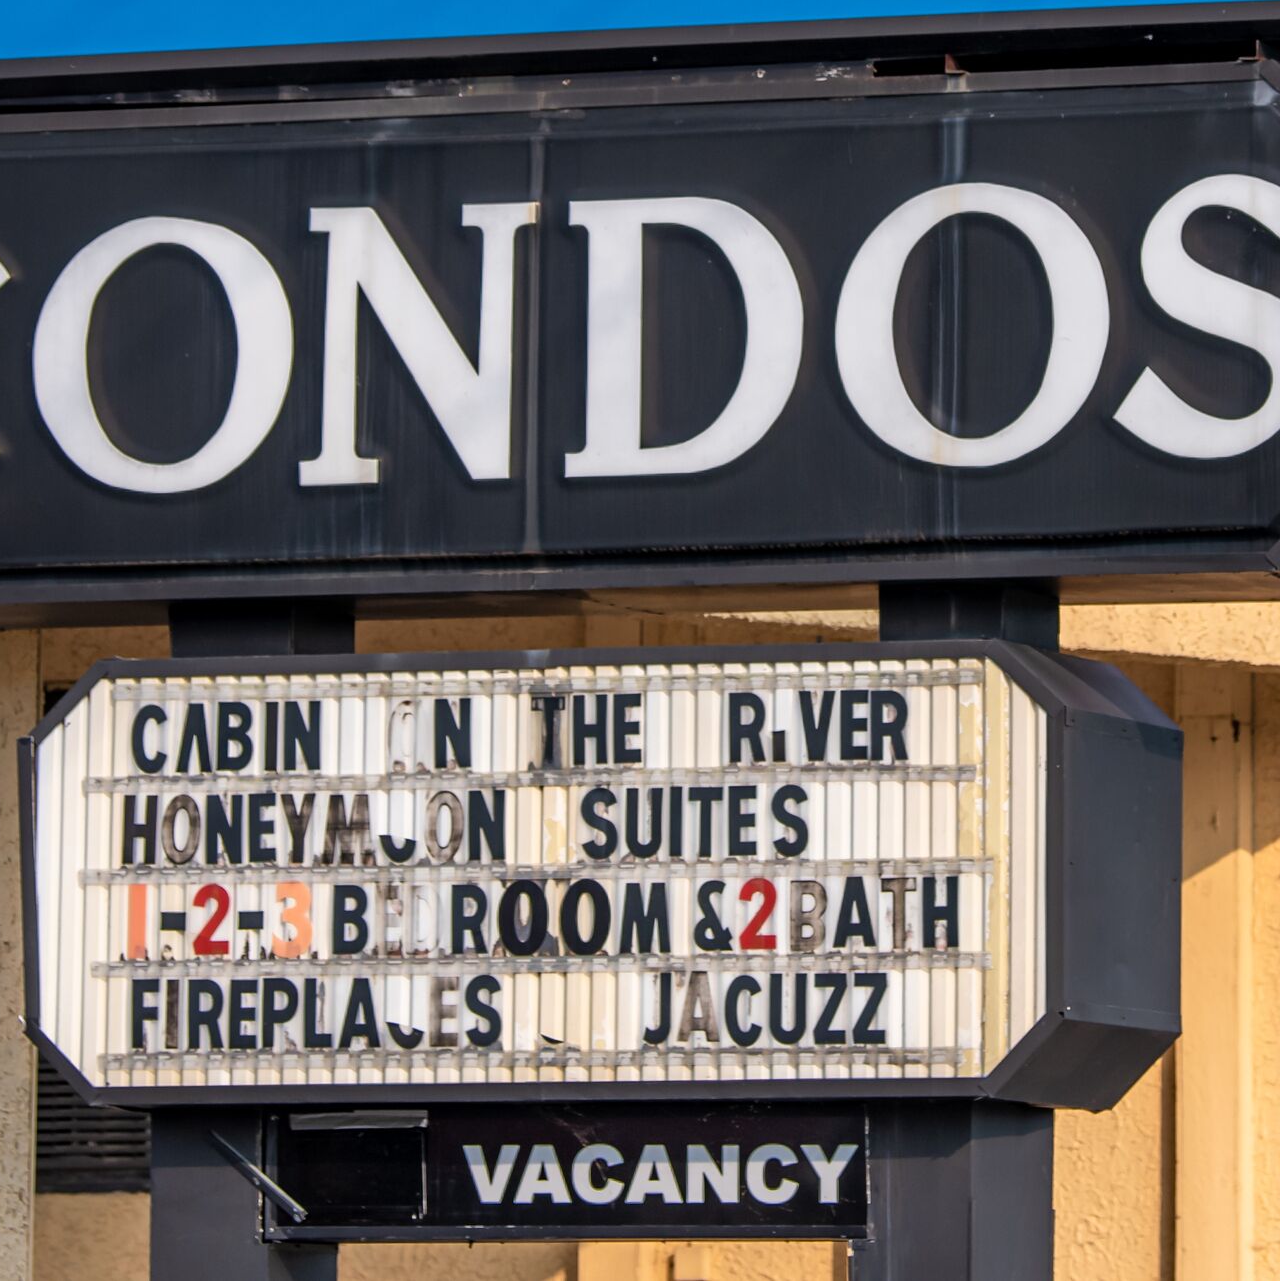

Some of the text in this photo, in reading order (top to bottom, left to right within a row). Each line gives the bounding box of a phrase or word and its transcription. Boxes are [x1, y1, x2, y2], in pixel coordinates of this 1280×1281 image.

[131, 700, 321, 774] CABIN
[531, 692, 642, 766] THE
[580, 784, 809, 860] SUITES
[332, 878, 671, 957] BEROOM
[643, 970, 888, 1047] JACUZZ
[462, 1144, 859, 1205] VACANCY
